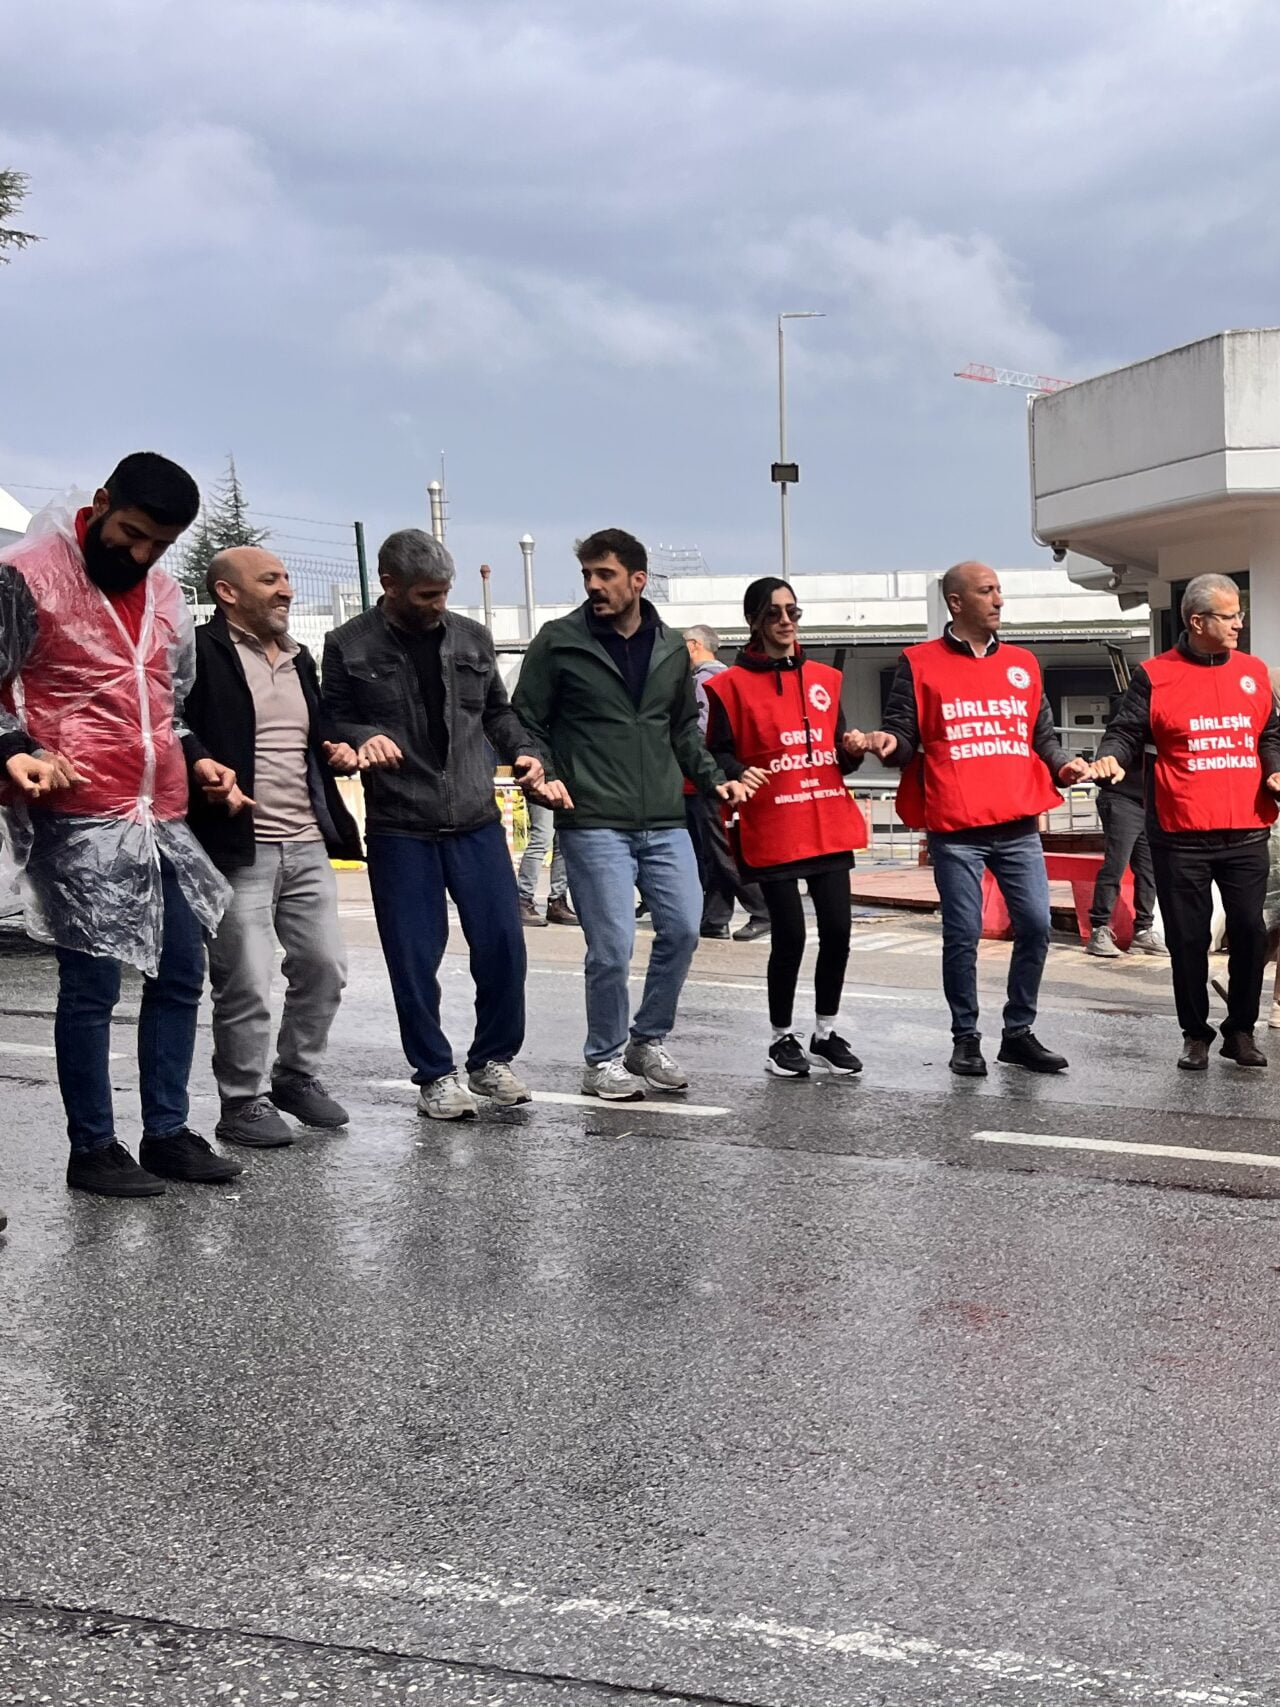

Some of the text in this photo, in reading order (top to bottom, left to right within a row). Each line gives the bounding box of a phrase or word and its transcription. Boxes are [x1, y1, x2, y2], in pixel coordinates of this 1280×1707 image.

[942, 696, 1028, 720] BİRLEŞİK
[945, 721, 1006, 741] METAL
[1017, 718, 1028, 740] İŞ
[1189, 713, 1252, 731] BİRLEŞİK
[950, 737, 1030, 760] SENDİKASI
[1188, 736, 1235, 751] METAL
[1244, 733, 1255, 752] İŞ
[1188, 753, 1257, 771] SENDİKASI
[774, 791, 813, 805] BİRLEŞİK
